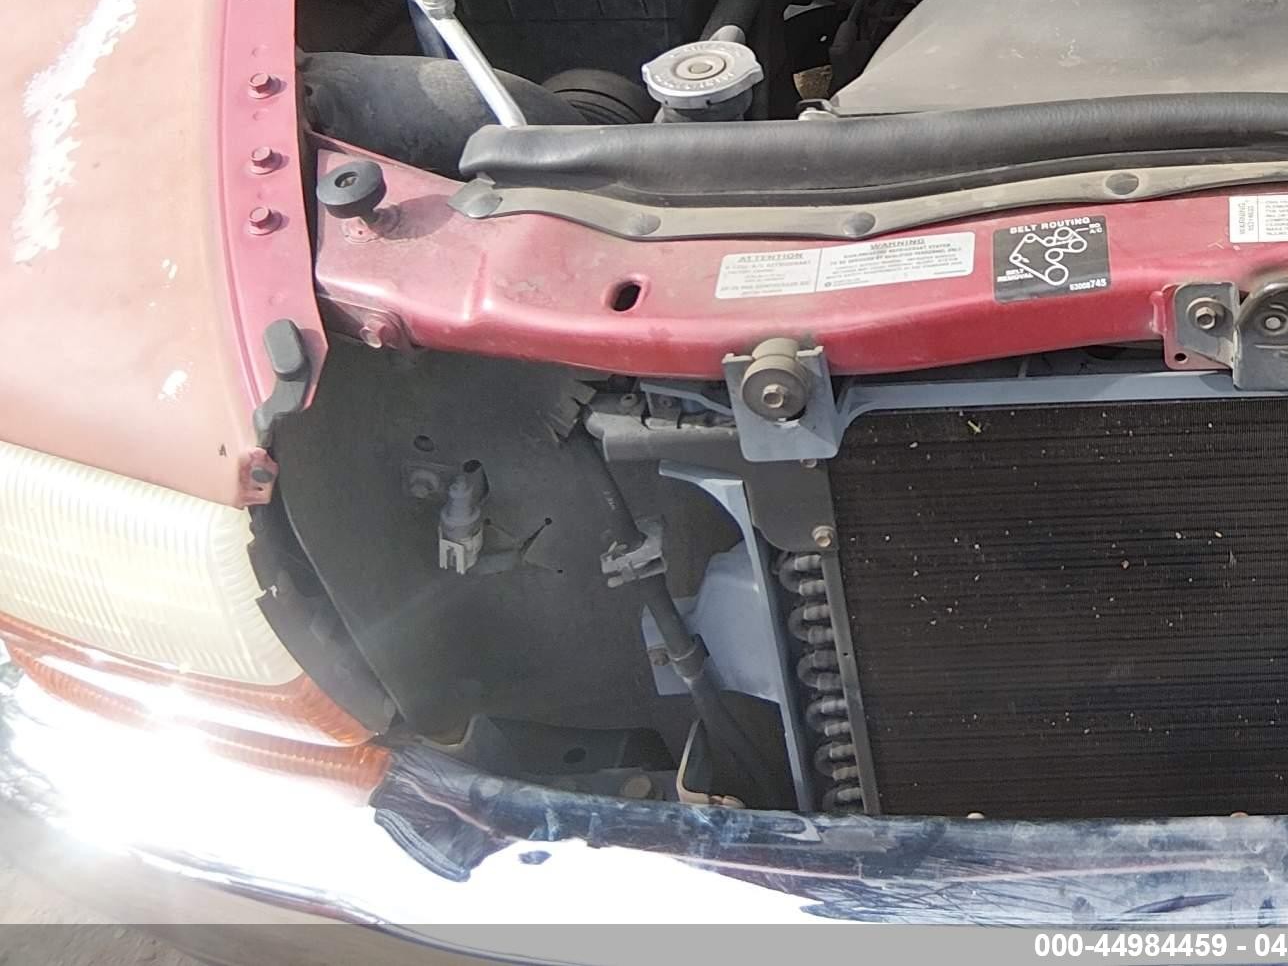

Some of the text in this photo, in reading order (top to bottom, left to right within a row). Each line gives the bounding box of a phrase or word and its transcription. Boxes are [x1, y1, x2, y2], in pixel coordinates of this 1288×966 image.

[1009, 216, 1091, 235] BELT ROUTING
[870, 238, 925, 250] WARNING
[737, 252, 804, 263] ATTENTION
